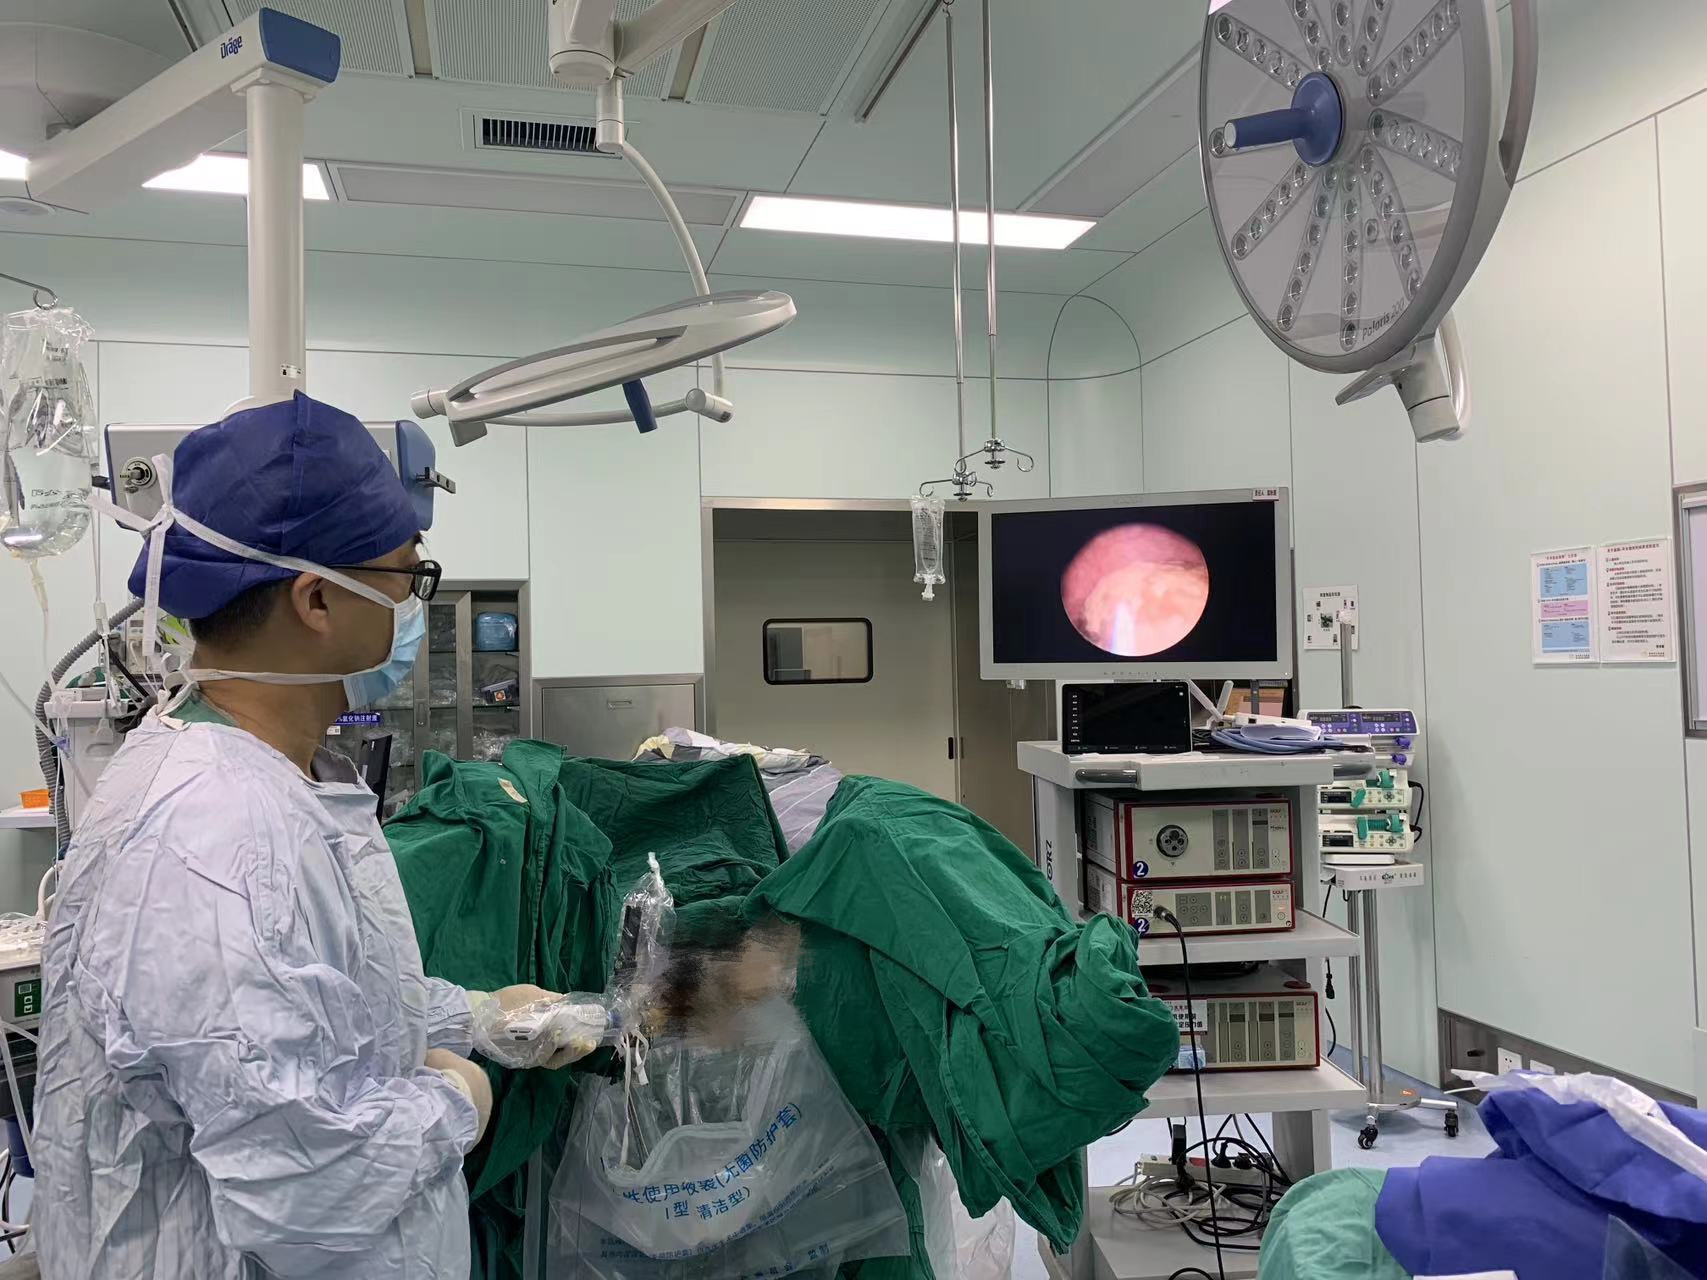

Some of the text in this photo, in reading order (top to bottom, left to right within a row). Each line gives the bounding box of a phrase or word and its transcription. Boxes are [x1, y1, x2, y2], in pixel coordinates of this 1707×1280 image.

[1362, 312, 1390, 341] Polaris
[1136, 862, 1144, 876] 2
[1138, 919, 1146, 932] 2
